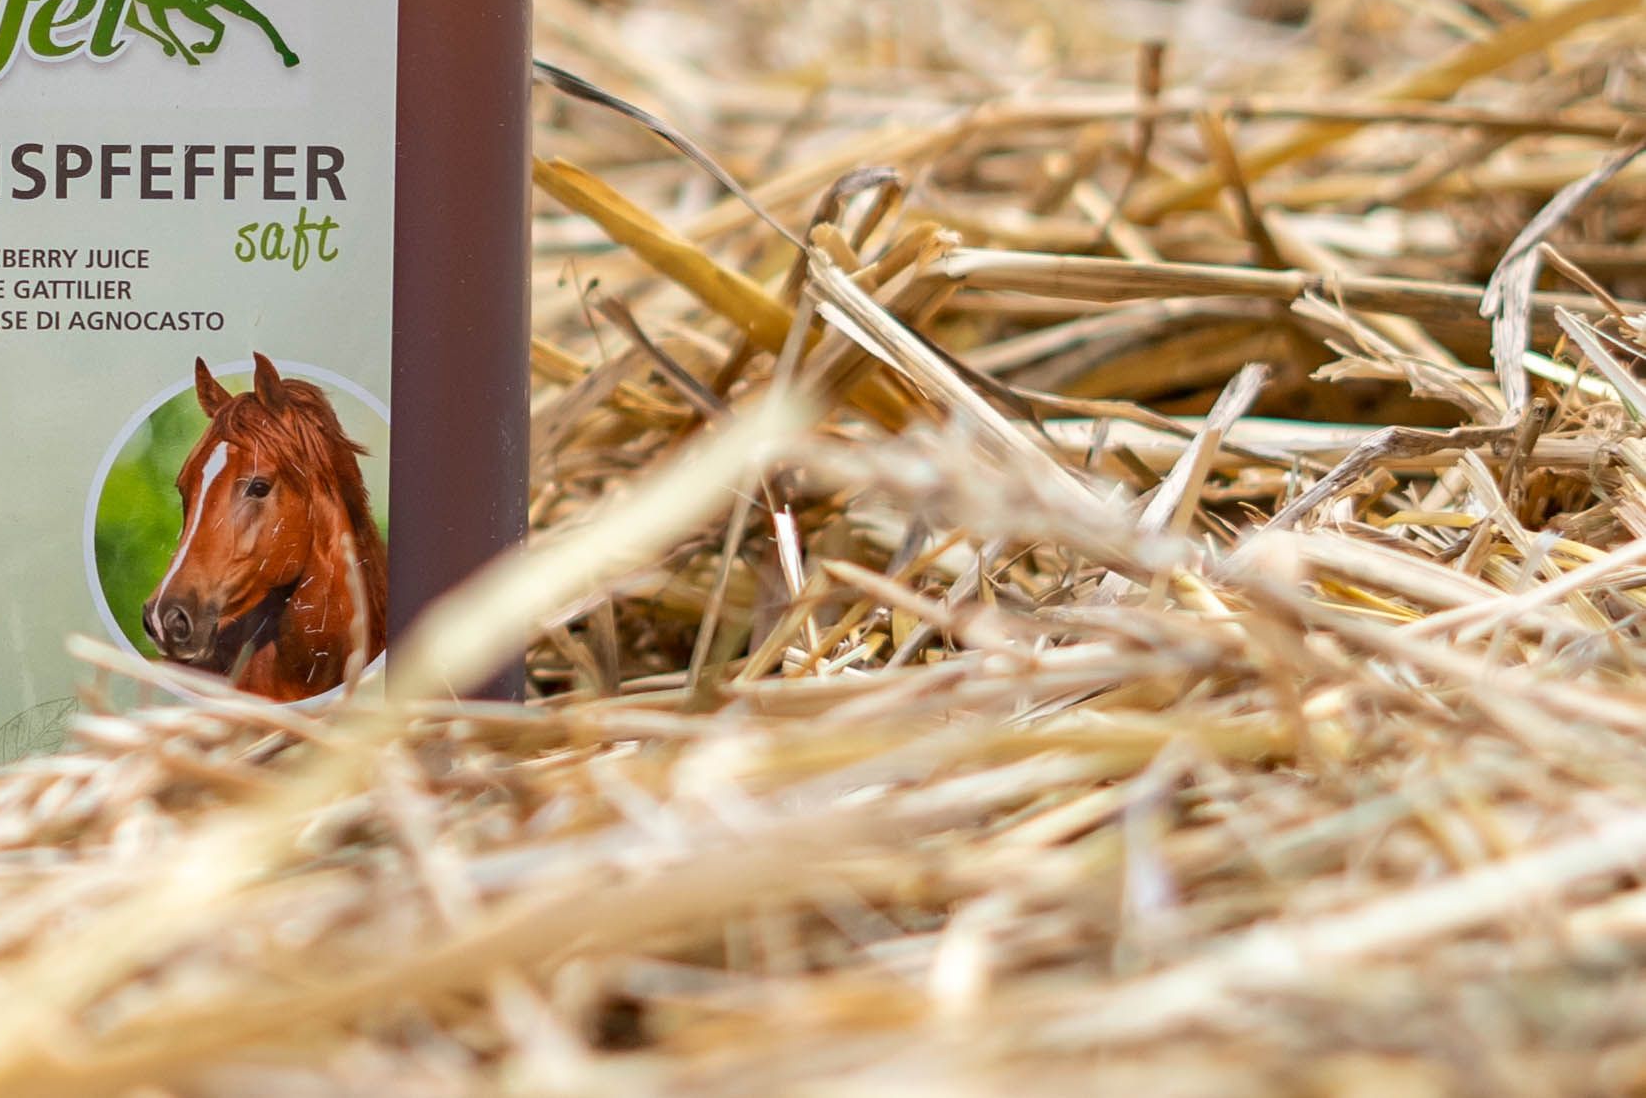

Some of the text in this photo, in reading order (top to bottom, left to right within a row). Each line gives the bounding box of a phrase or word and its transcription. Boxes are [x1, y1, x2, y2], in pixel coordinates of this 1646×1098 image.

[234, 206, 340, 272] saft
[85, 249, 150, 269] JUICE
[13, 279, 132, 300] GATTILIER
[36, 310, 60, 331] DI
[67, 311, 225, 331] AGNOCASTO
